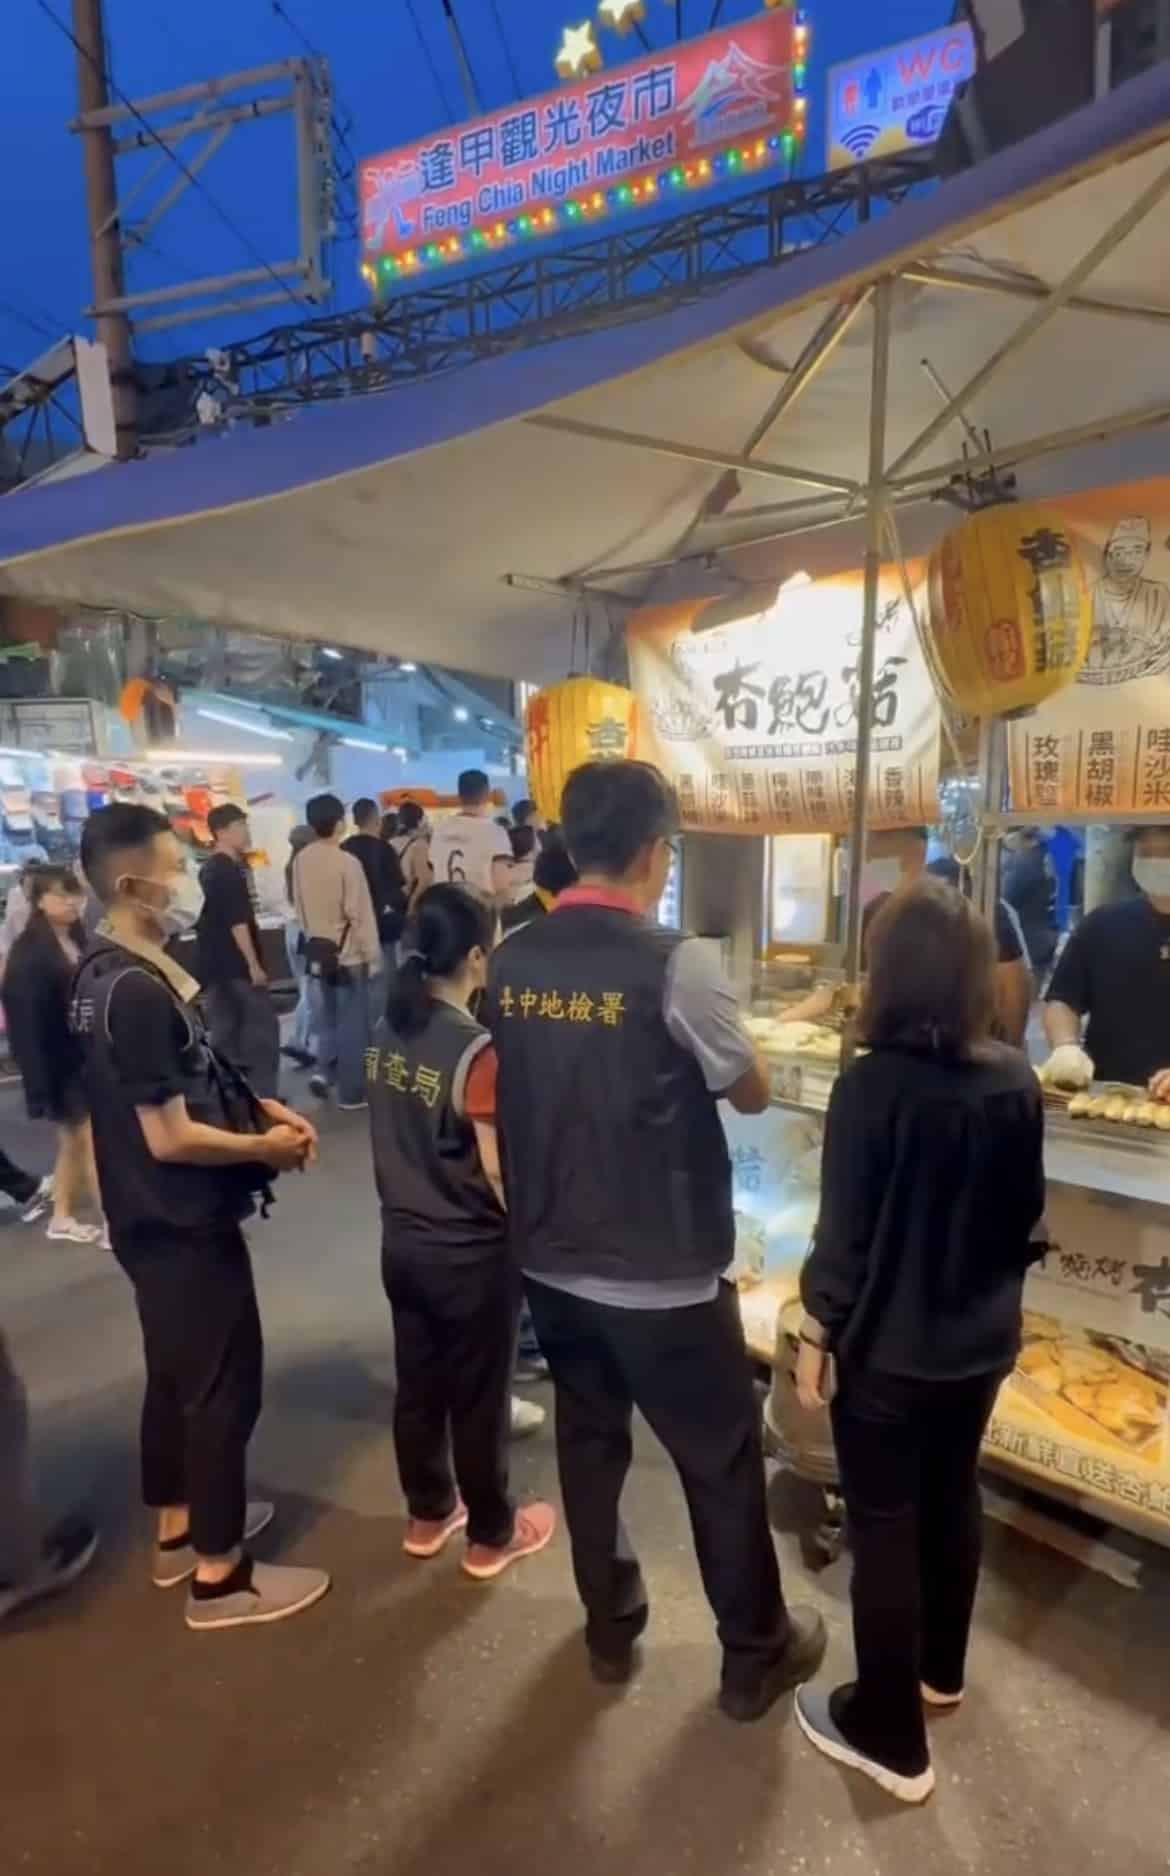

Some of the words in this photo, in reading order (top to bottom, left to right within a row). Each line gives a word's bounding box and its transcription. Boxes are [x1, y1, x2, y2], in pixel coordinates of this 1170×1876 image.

[896, 38, 964, 87] WC
[420, 65, 676, 193] 逢甲觀光夜市
[422, 202, 472, 232] Feng
[478, 184, 524, 215] Chia
[531, 165, 589, 205] Night
[597, 131, 674, 172] Market
[1085, 730, 1115, 807] 黑胡椒
